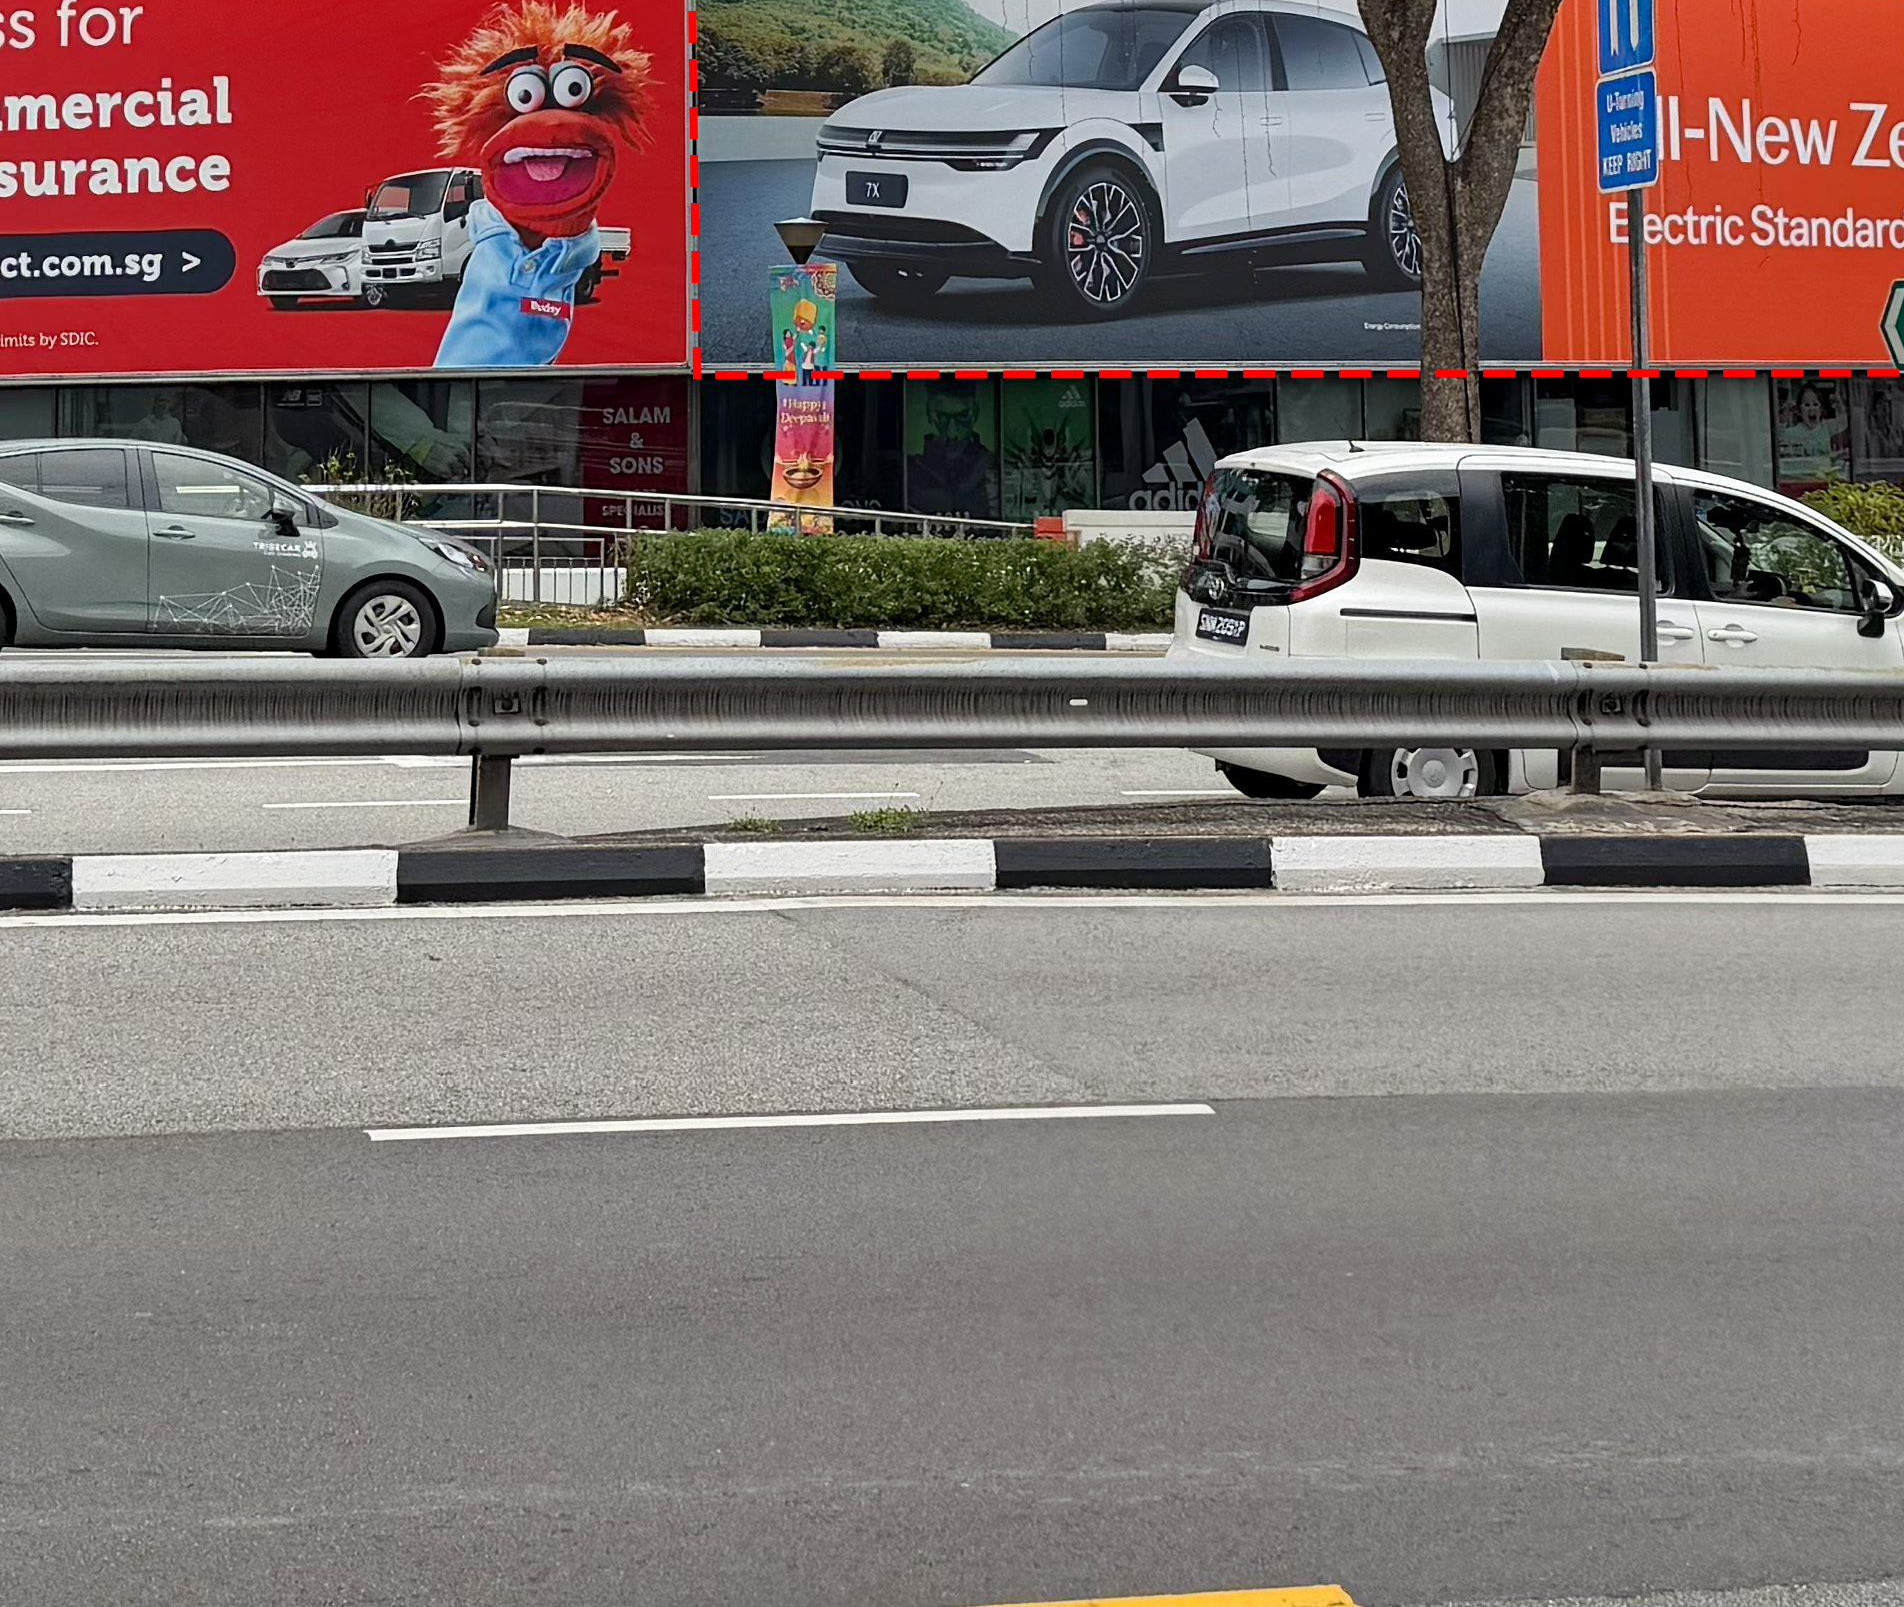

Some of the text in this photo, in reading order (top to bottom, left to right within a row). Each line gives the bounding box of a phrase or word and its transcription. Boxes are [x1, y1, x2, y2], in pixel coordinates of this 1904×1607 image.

[1610, 120, 1643, 144] Vehicles
[1656, 95, 1838, 166] ll-New
[1602, 149, 1652, 176] KEEP RIGHT
[865, 182, 880, 198] 7X
[1609, 201, 1745, 246] Eectric
[39, 332, 57, 349] by
[60, 331, 99, 346] SDIC.
[602, 406, 671, 424] SALAM
[629, 432, 644, 449] &
[609, 457, 664, 474] SONS
[1129, 481, 1202, 511] adid
[602, 505, 667, 517] SPEIALIS
